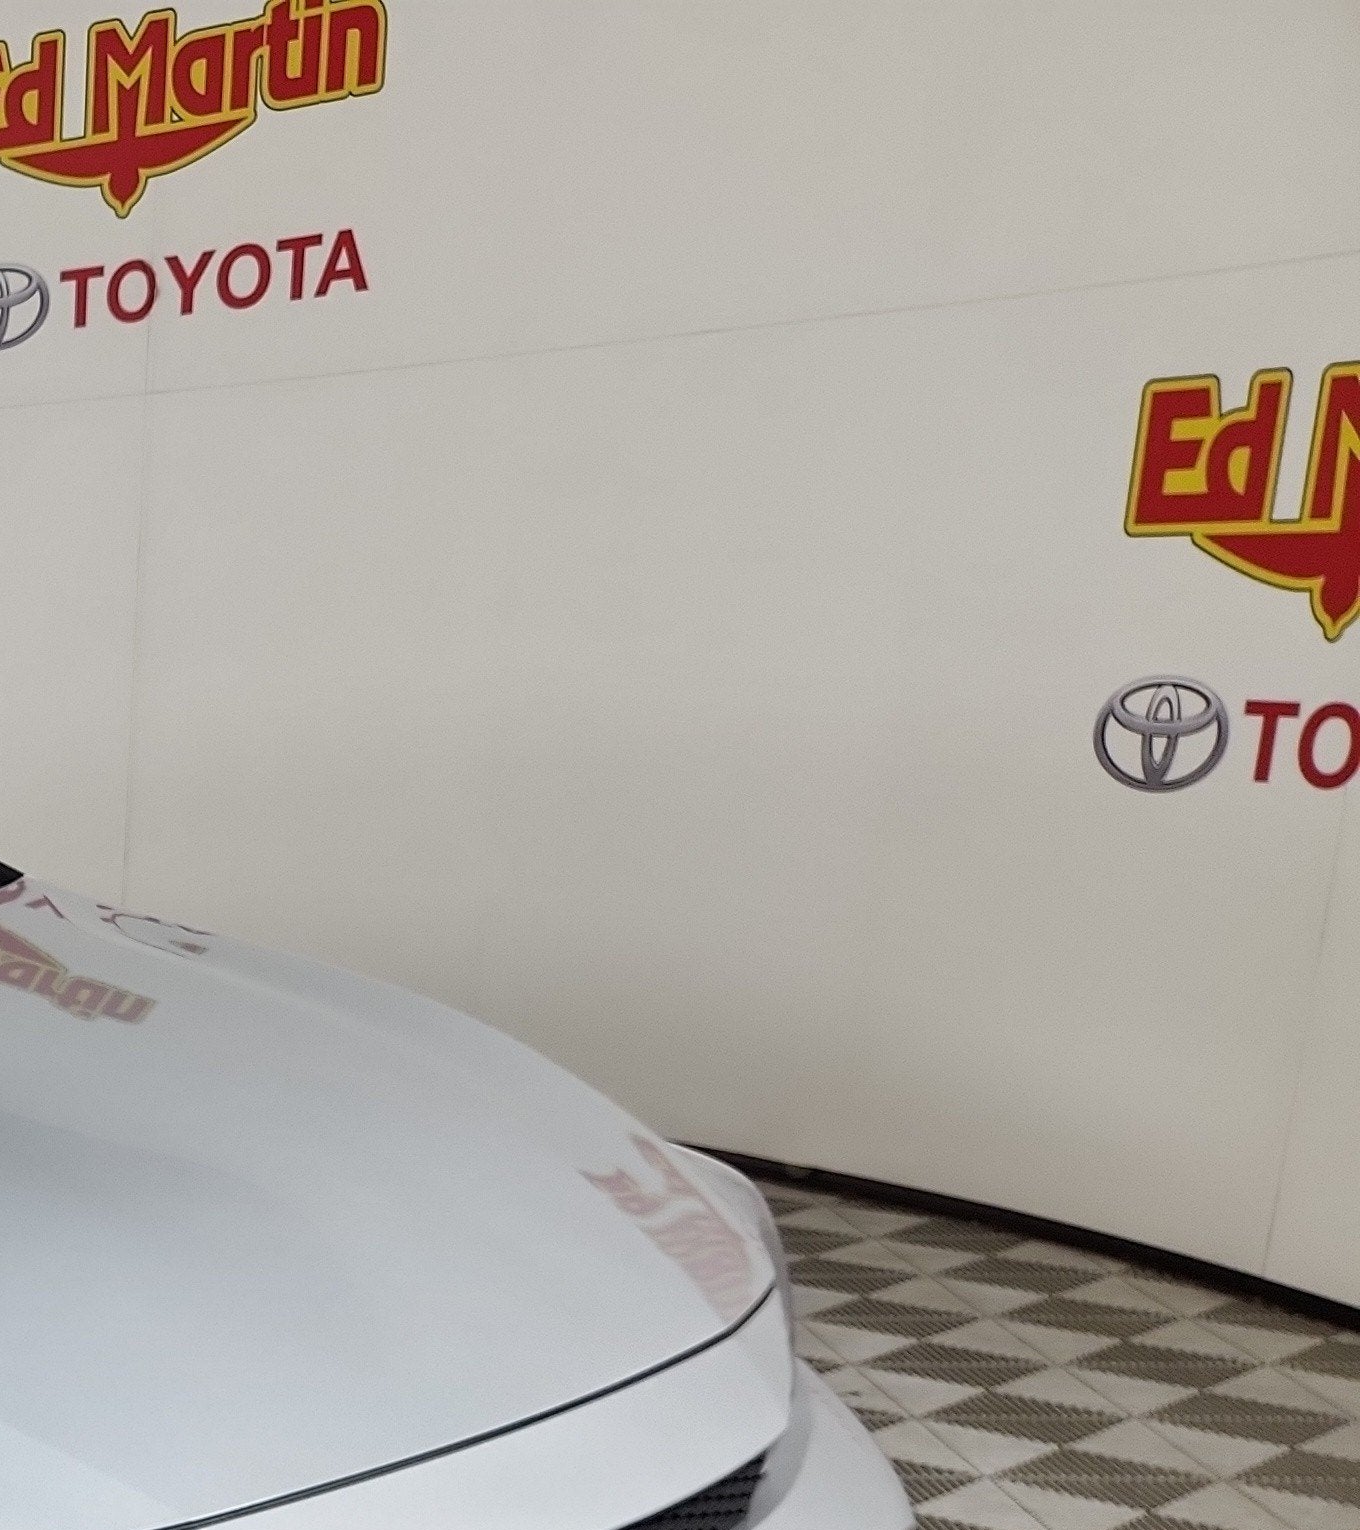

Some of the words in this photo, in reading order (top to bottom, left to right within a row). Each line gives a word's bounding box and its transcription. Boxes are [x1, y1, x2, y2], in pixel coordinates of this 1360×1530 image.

[90, 0, 381, 138] Martin
[60, 229, 369, 328] TOYOTA
[1132, 377, 1285, 526] Ed
